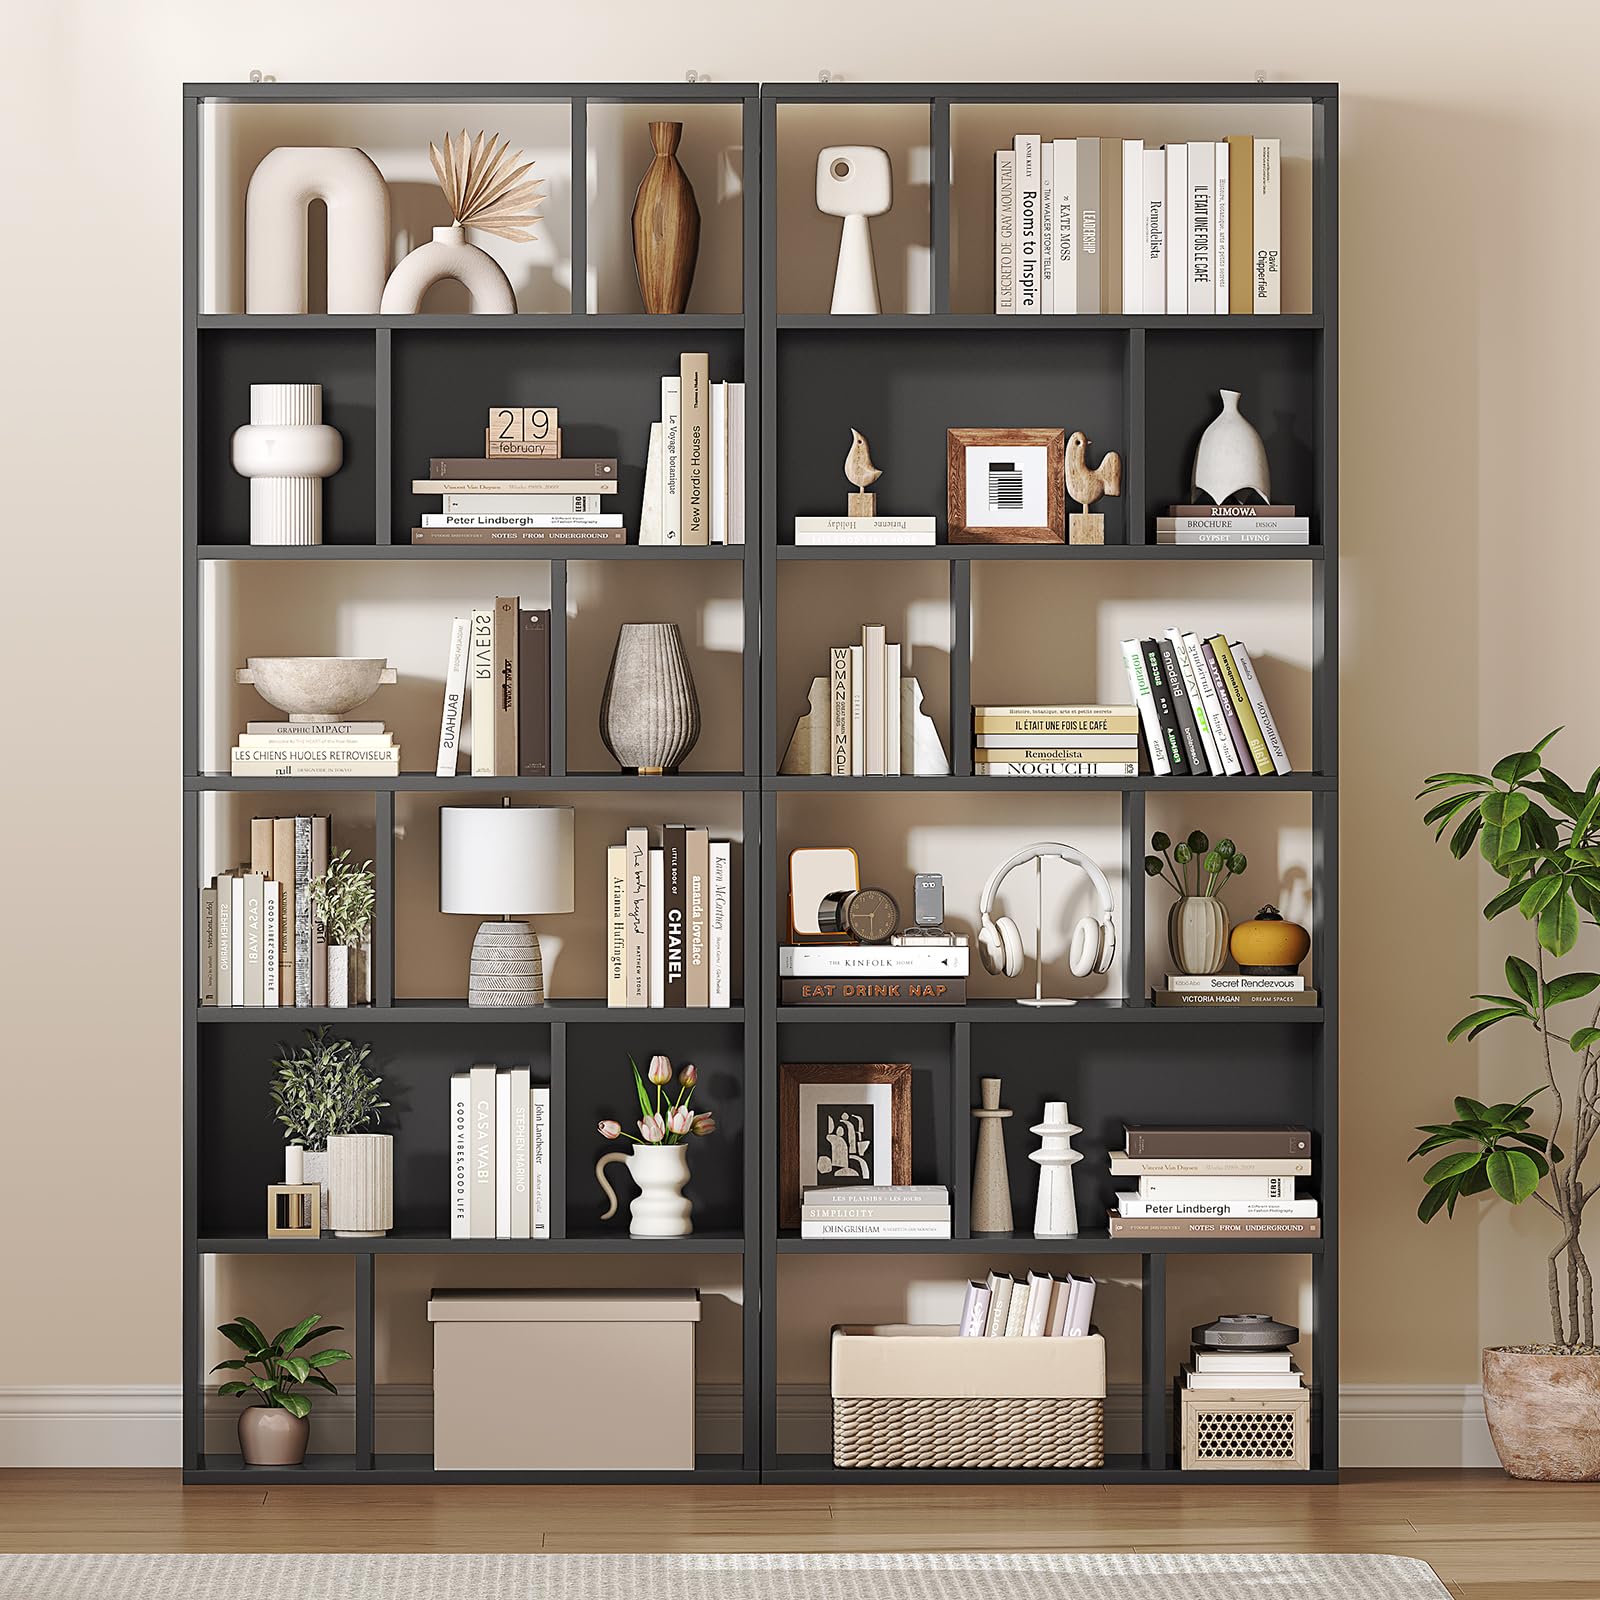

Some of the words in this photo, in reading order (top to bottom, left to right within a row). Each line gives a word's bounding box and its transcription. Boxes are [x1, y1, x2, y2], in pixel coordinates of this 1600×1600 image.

[1001, 161, 1012, 212] MOUNTAIN
[1194, 185, 1208, 193] IL
[1023, 191, 1037, 237] Rooms
[1194, 194, 1211, 215] ÉTAIT
[1001, 214, 1012, 238] GRAY
[1060, 204, 1071, 231] KATE
[1194, 217, 1208, 232] UNE
[1083, 210, 1096, 254] LEADERSHIP
[1150, 201, 1162, 259] Remodelista
[1001, 243, 1012, 254] DE
[1023, 241, 1036, 255] to
[1060, 234, 1071, 261] MOSS
[1194, 234, 1208, 251] FOIS
[1194, 253, 1208, 261] LE
[1268, 250, 1278, 272] David
[1001, 257, 1012, 295] SECRETO
[1019, 260, 1038, 306] Inspire
[1194, 263, 1211, 283] CAFÉ
[1257, 250, 1267, 298] Chipperfield
[1001, 298, 1012, 307] EL
[670, 415, 677, 424] Le
[499, 442, 546, 455] february
[668, 426, 677, 453] Voyage
[690, 425, 701, 466] Houses
[669, 456, 677, 495] botanique
[690, 469, 701, 504] Nordic
[446, 516, 475, 525] Peter
[478, 516, 533, 527] Lindbergh
[690, 506, 701, 531] New
[1211, 507, 1257, 516] RIMOWA
[827, 520, 856, 530] Holiday
[1187, 520, 1233, 528] BROCHURE
[1199, 534, 1230, 542] GYPSET
[1241, 534, 1270, 542] LIVING
[311, 725, 352, 733] IMPACT
[1015, 720, 1023, 731] IL
[1024, 718, 1044, 731] ÉTAIT
[1045, 720, 1060, 731] UNE
[1062, 720, 1077, 731] FOIS
[1079, 720, 1088, 731] LE
[1089, 718, 1108, 731] CAFÉ
[235, 750, 251, 761] LES
[253, 750, 288, 761] CHIENS
[290, 750, 327, 761] HUOLES
[330, 750, 392, 761] RETROVISEUR
[1025, 750, 1083, 759] Remodelista
[1007, 763, 1098, 774] NOGUCHI
[633, 845, 644, 868] The
[715, 856, 726, 882] Karen
[613, 877, 624, 918] Arianna
[671, 886, 678, 895] OF
[692, 875, 703, 918] amanda
[628, 898, 644, 934] beyond
[712, 885, 726, 931] McCartney
[611, 922, 624, 980] Huffington
[668, 909, 682, 983] CHANEL
[692, 921, 703, 966] lovelace
[845, 959, 893, 967] KINFOLK
[802, 984, 836, 997] EAT
[843, 984, 900, 997] DRINK
[909, 984, 947, 997] NAP
[1210, 979, 1239, 988] Secret
[1241, 979, 1295, 988] Rendezvous
[456, 1102, 464, 1130] GOOD
[477, 1100, 489, 1140] CASA
[534, 1103, 544, 1121] John
[515, 1107, 525, 1151] STEPHEN
[536, 1123, 544, 1164] Lanchester
[477, 1144, 489, 1183] WABI
[515, 1153, 525, 1192] MARINO
[456, 1198, 464, 1219] LIFE
[810, 1209, 874, 1217] SIMPLICITY
[1145, 1204, 1173, 1213] Peter
[1176, 1204, 1231, 1215] Lindbergh
[1189, 1224, 1215, 1232] NOTES
[1219, 1224, 1241, 1232] FROM
[1245, 1224, 1304, 1232] UNDERGROUND
